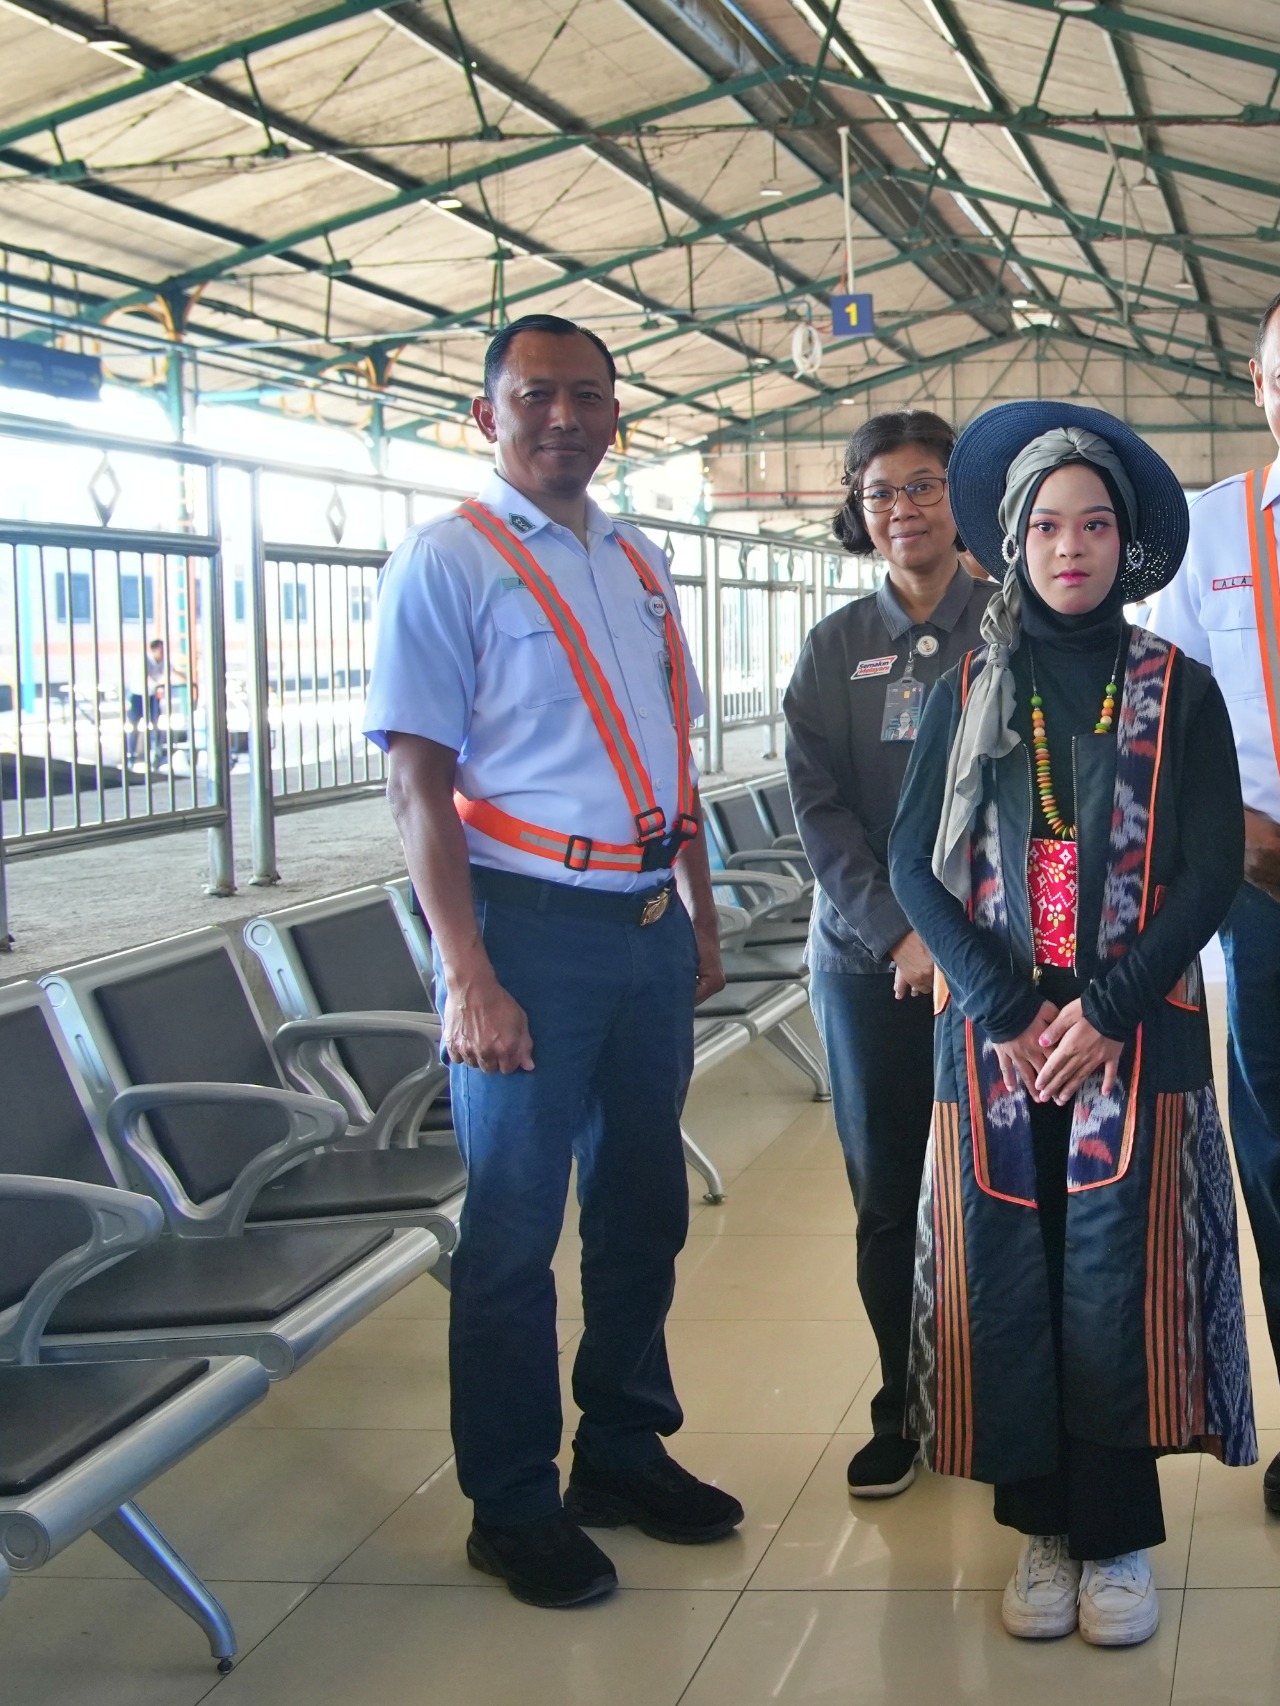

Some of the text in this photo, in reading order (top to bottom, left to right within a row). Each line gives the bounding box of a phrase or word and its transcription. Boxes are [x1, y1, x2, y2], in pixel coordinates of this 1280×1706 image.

[844, 302, 858, 327] 1
[858, 665, 890, 674] Melayani
[859, 661, 889, 669] Semakin
